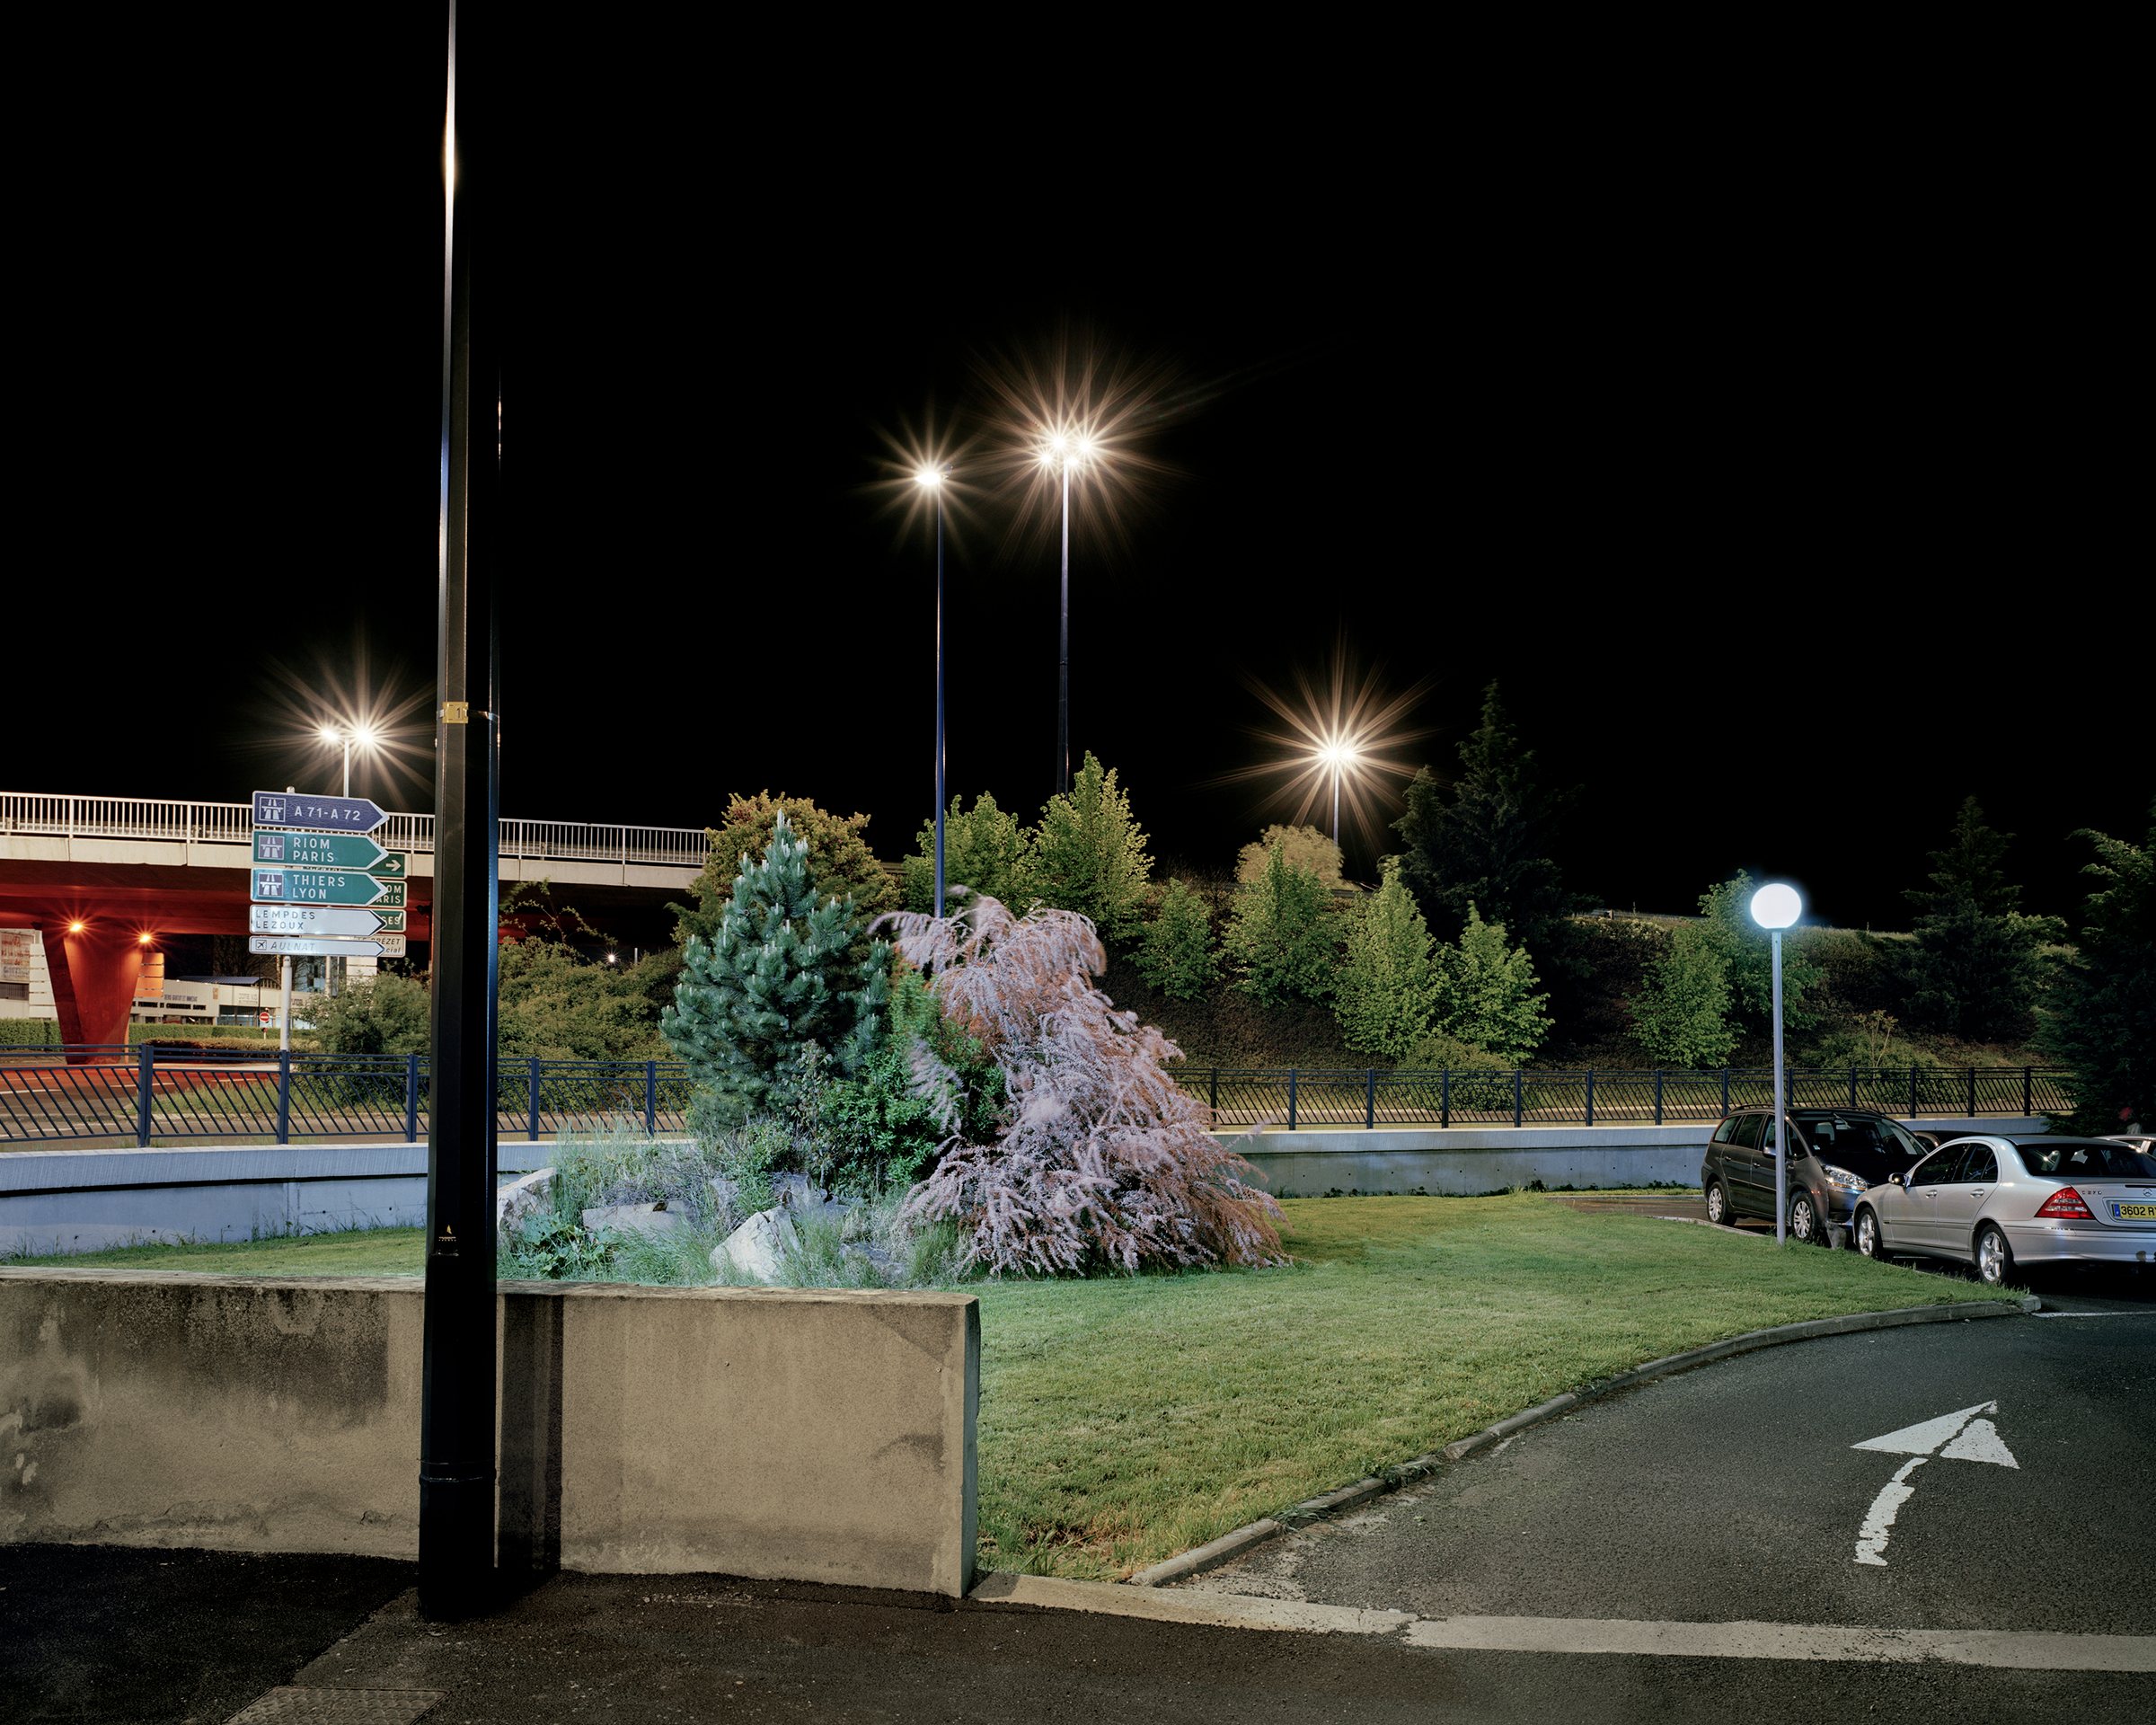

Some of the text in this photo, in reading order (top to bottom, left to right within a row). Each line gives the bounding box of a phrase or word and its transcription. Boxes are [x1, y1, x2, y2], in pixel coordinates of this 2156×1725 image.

[295, 806, 303, 817] A
[343, 809, 360, 821] 72
[293, 836, 330, 850] RIOM
[293, 850, 334, 862] PARIS
[293, 874, 346, 888] THIERS
[292, 888, 327, 899] LYON
[386, 884, 402, 894] OM
[376, 895, 401, 904] ARIS
[255, 909, 315, 920] LEMPDES
[255, 920, 304, 930] LEZOUX
[270, 941, 316, 951] AULNAT
[2120, 1206, 2156, 1216] 3602 R
